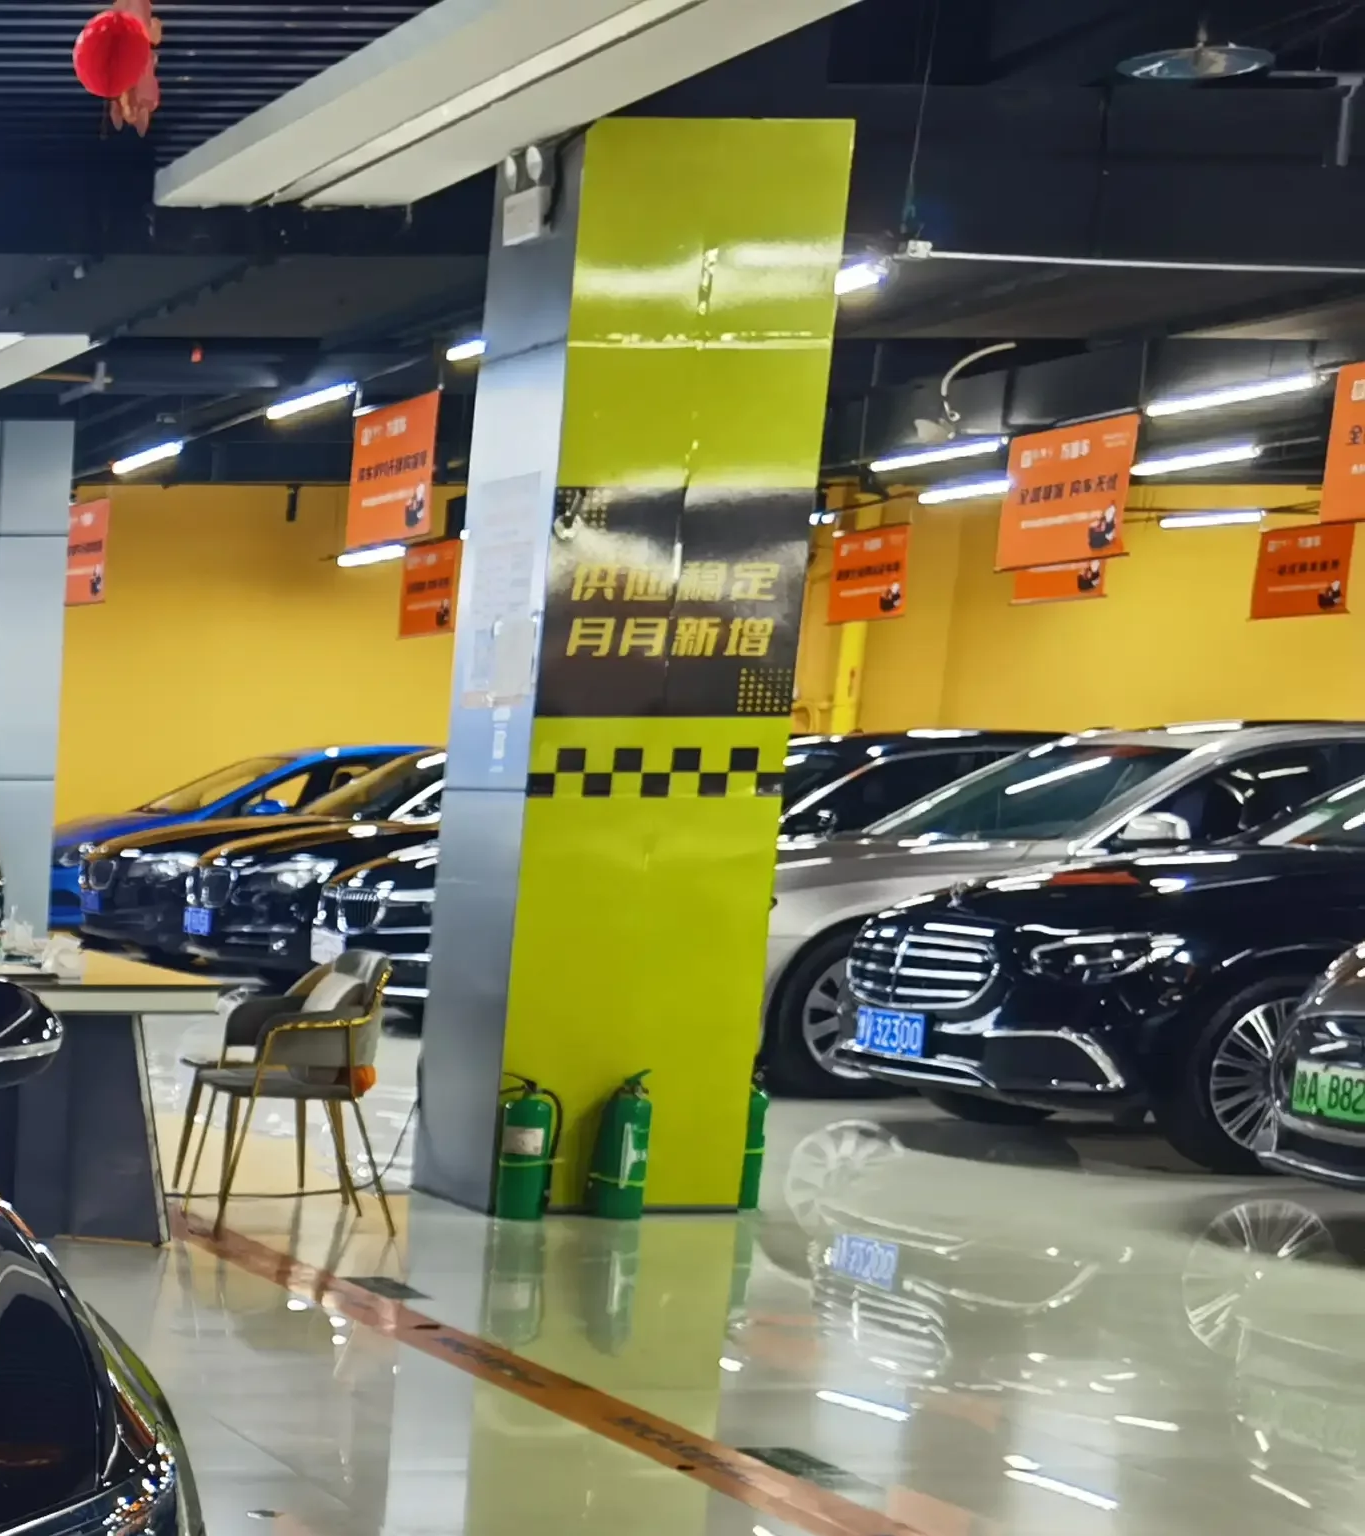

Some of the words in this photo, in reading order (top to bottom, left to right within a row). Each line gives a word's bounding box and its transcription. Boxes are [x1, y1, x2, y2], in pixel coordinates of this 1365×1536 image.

[571, 562, 781, 601] 供应稳定
[566, 616, 775, 657] 月月新增
